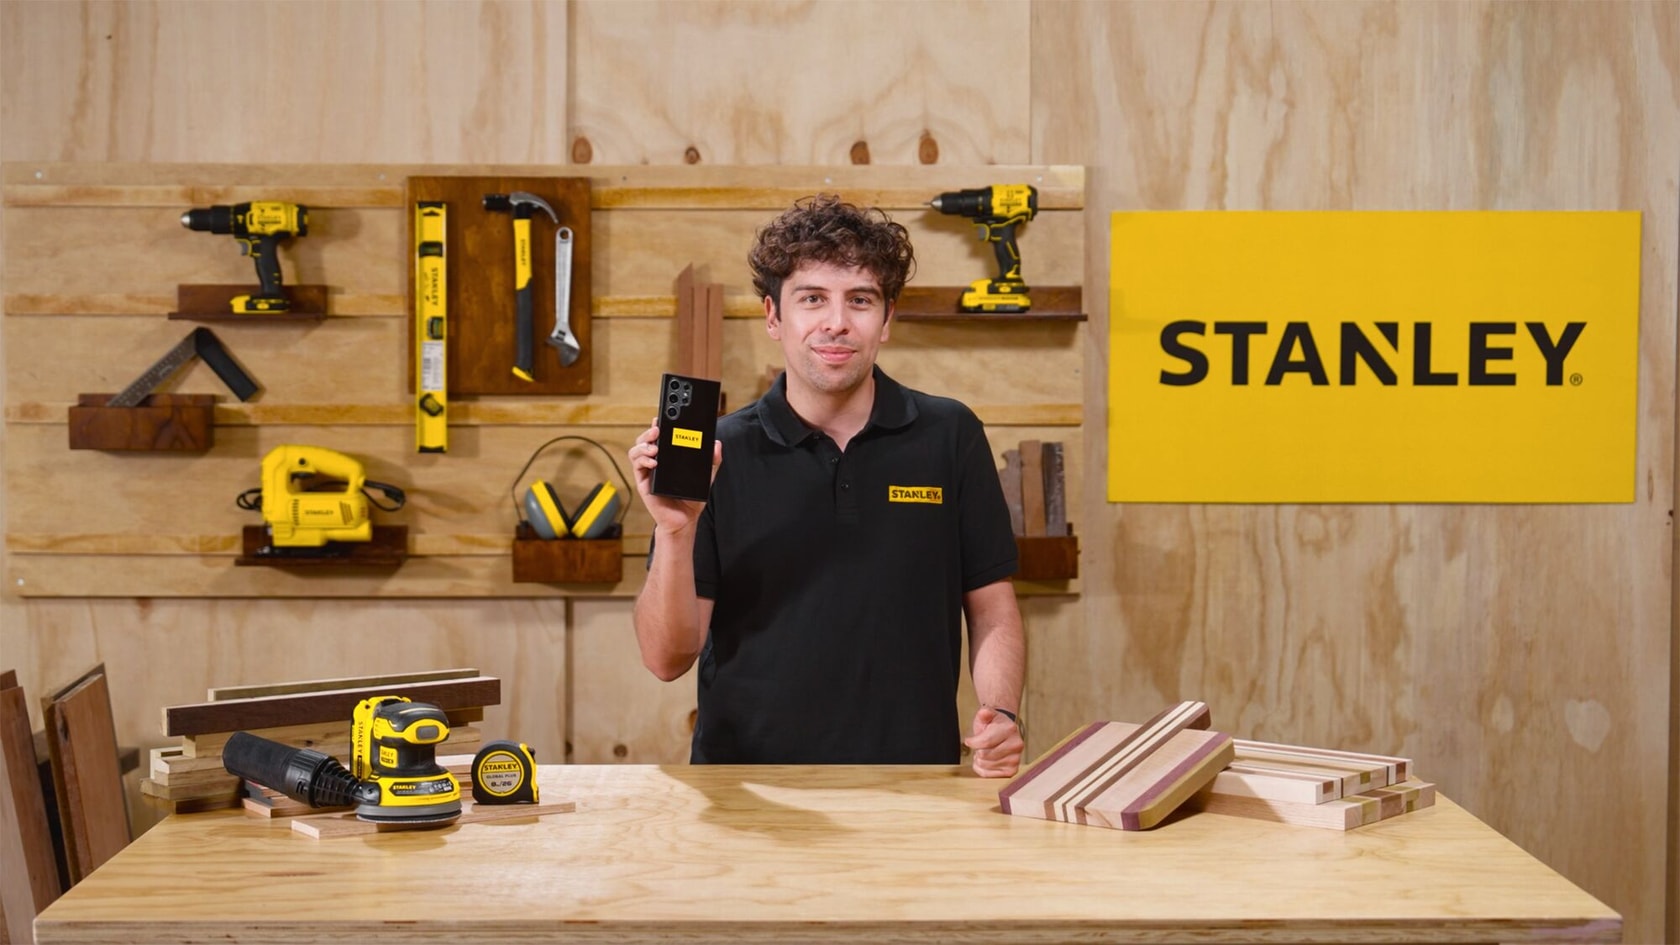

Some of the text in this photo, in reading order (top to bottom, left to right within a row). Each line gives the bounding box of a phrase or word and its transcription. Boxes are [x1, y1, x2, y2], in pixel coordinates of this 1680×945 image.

[431, 266, 439, 306] STANLEY
[674, 433, 700, 442] STANLEY
[484, 763, 518, 771] STANLEY
